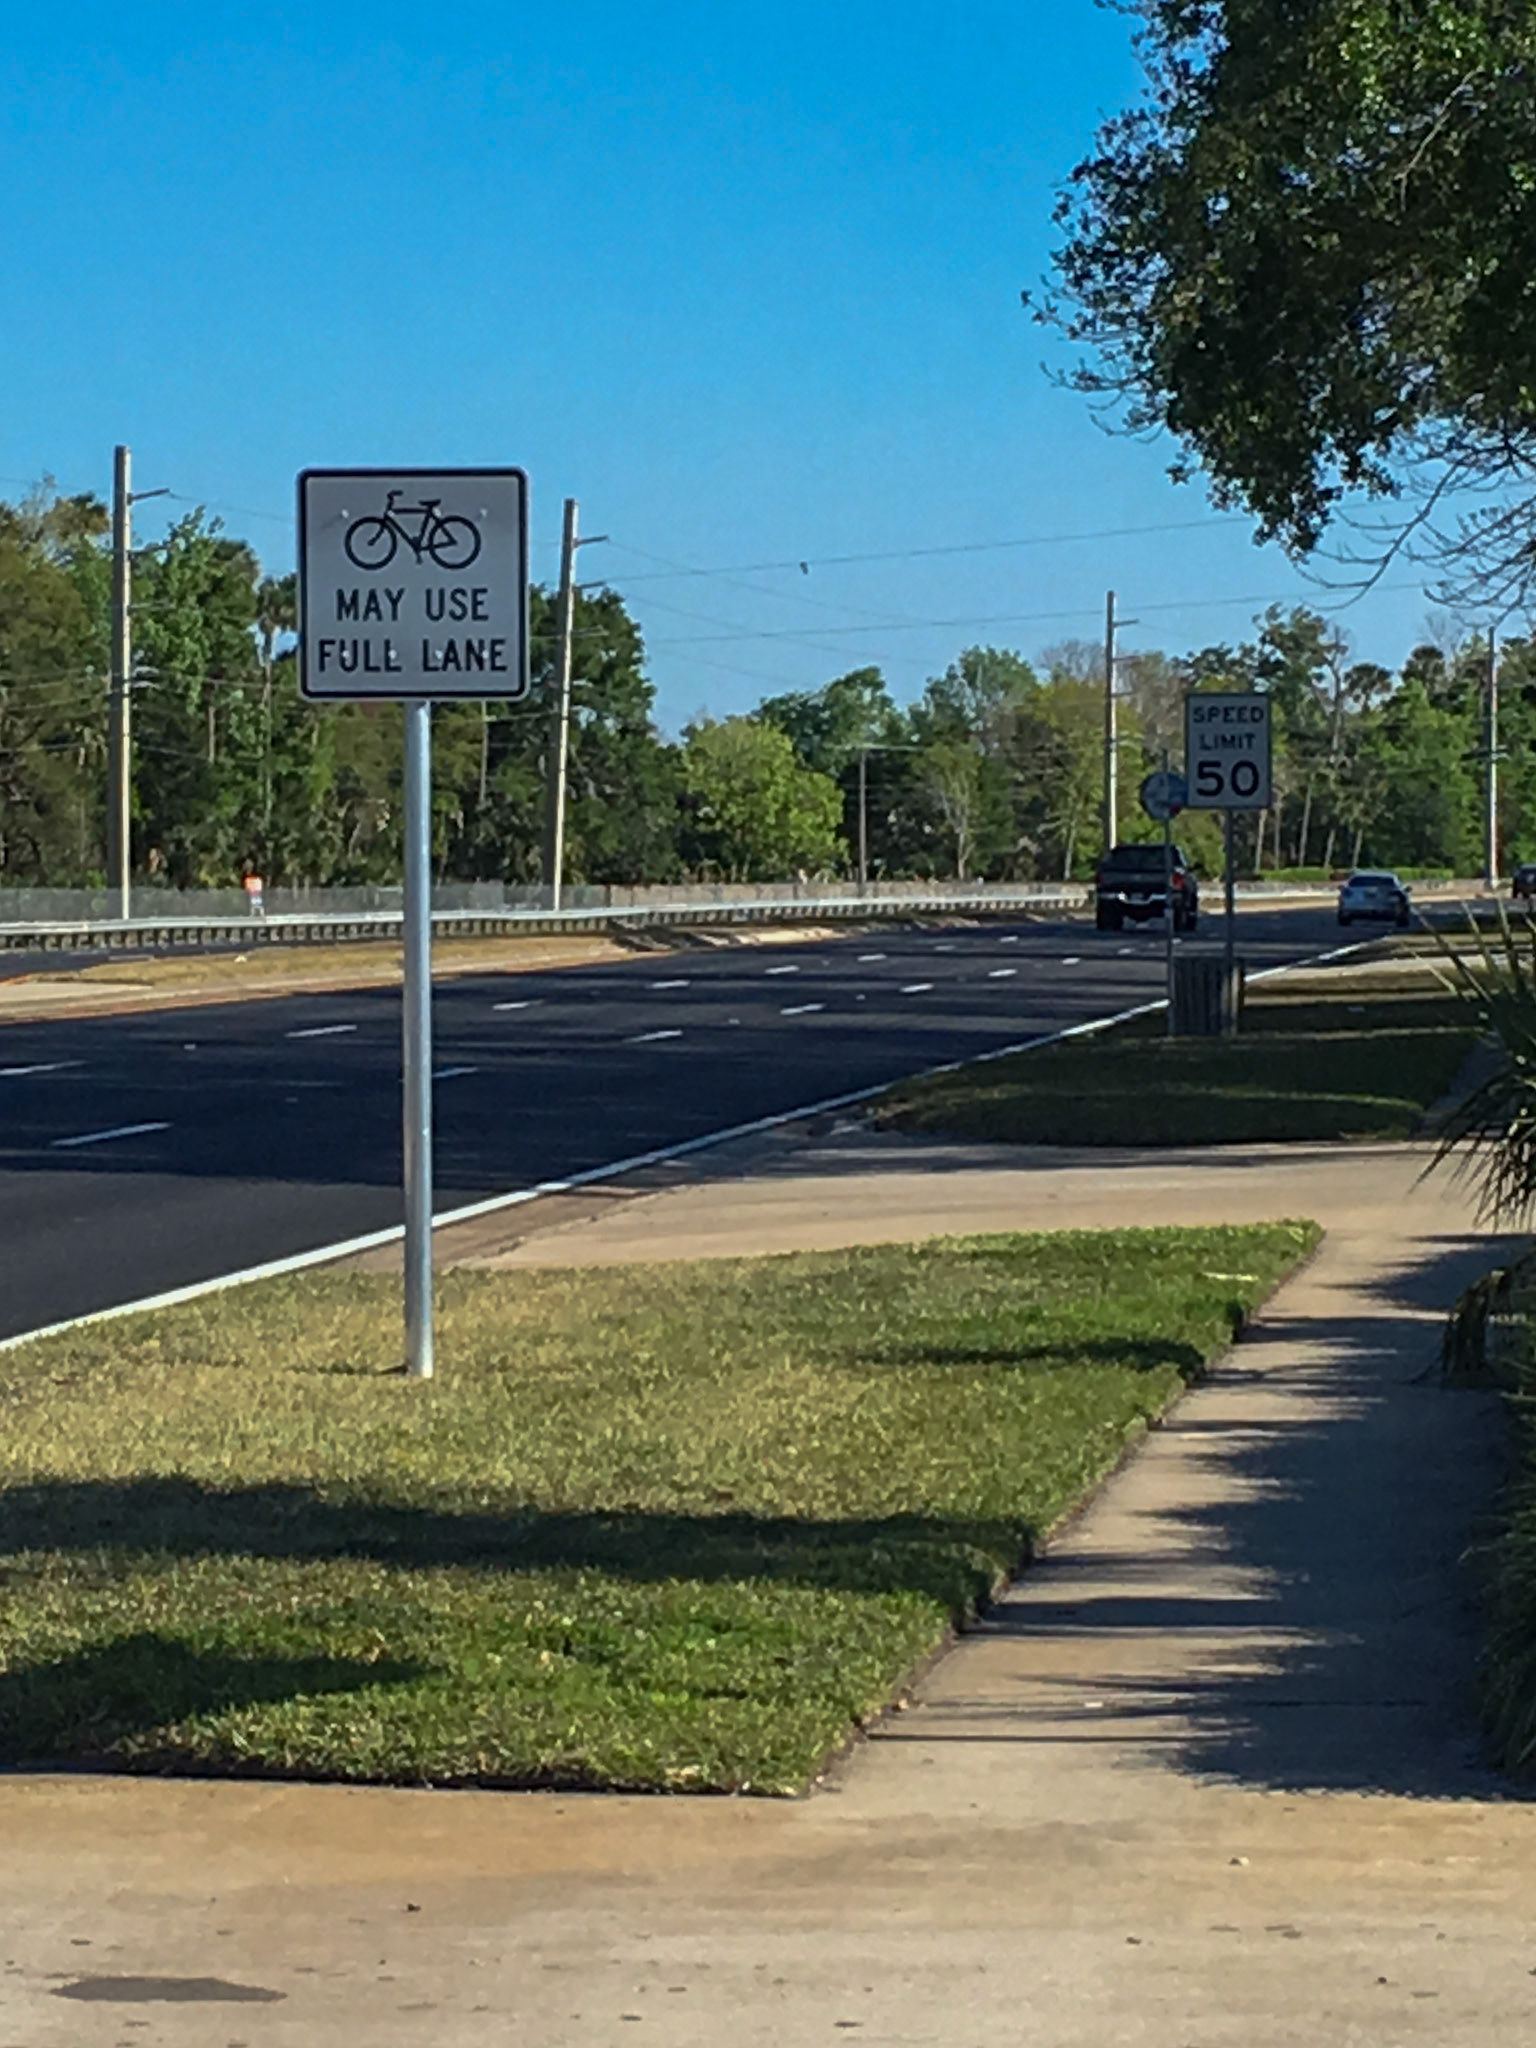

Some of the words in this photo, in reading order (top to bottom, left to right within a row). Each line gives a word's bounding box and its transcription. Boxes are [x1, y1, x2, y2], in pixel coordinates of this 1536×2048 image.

[336, 588, 404, 621] MAY
[425, 588, 488, 621] USE
[318, 639, 401, 672] FULL
[422, 639, 507, 672] LANE
[1193, 706, 1264, 723] SPEED
[1200, 733, 1255, 750] LIMIT
[1196, 760, 1259, 796] 50
